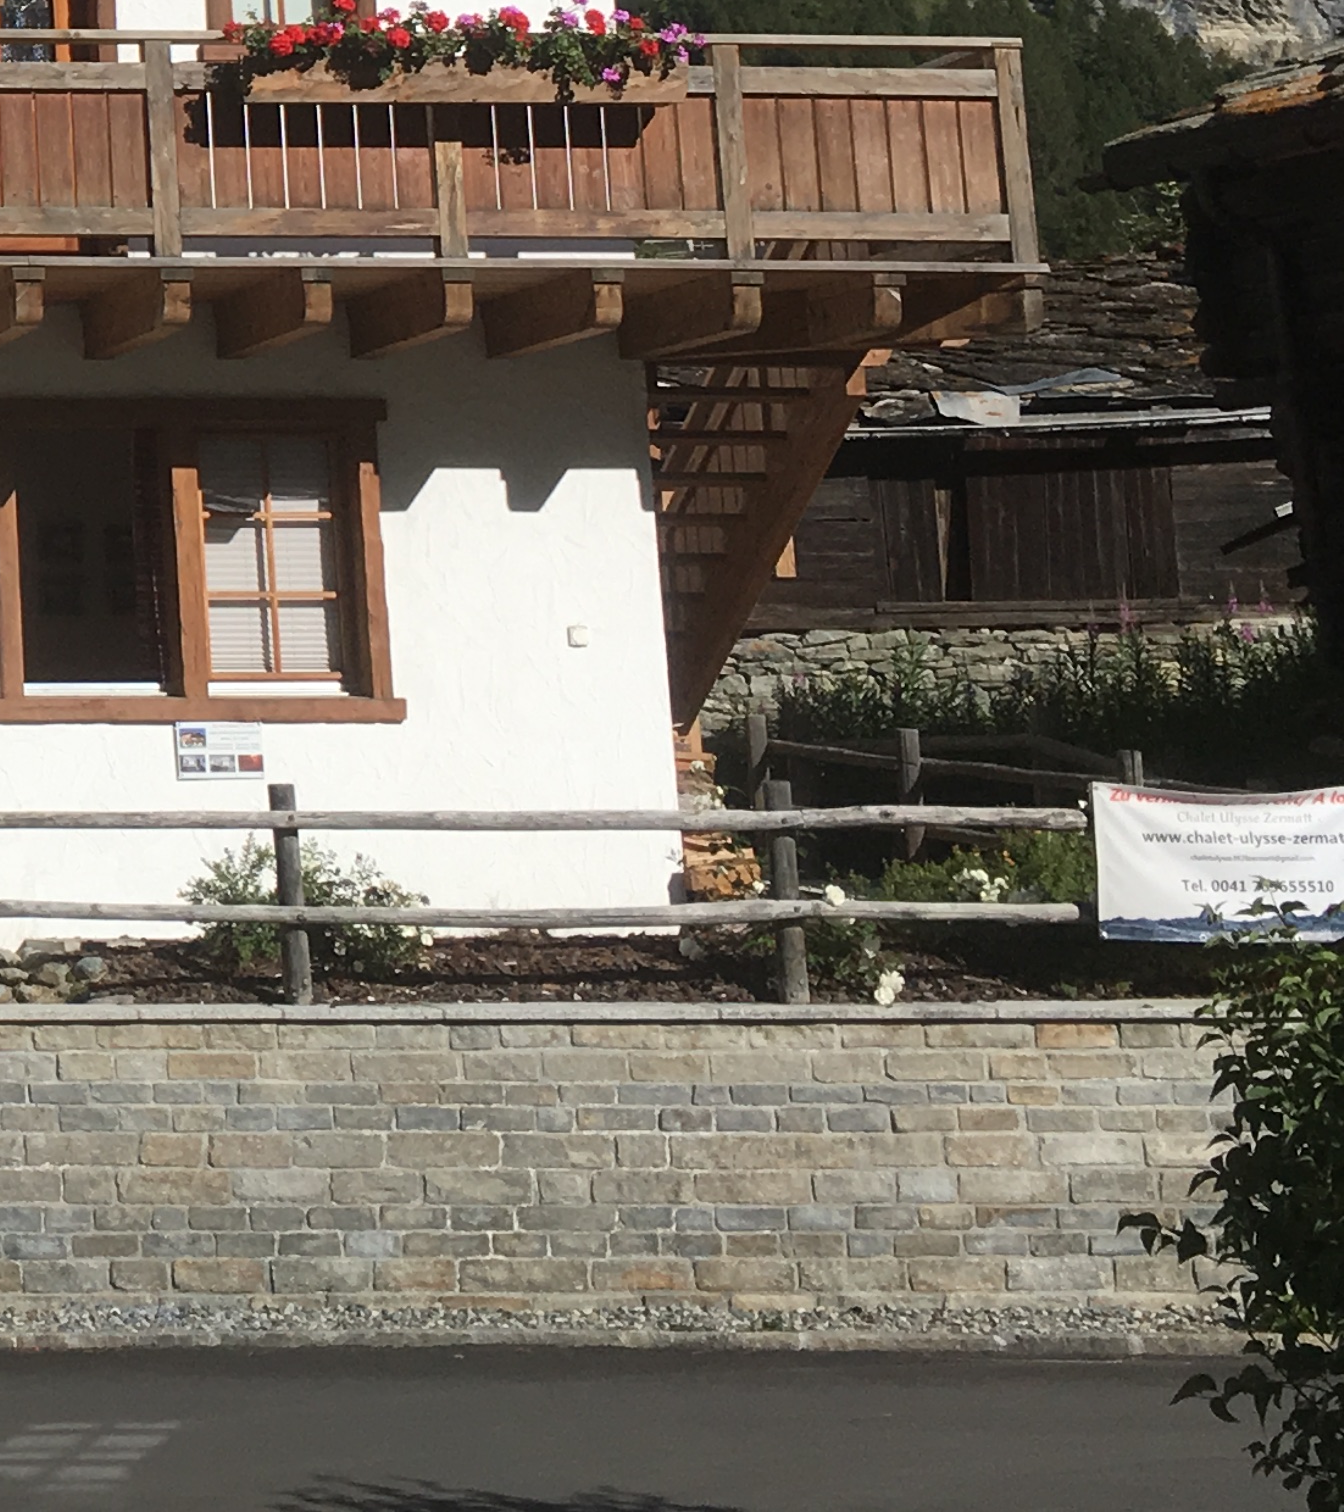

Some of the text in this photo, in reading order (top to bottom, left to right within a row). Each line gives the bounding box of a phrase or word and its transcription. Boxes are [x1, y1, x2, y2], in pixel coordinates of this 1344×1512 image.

[1177, 811, 1312, 826] Chalet Ulysse Zermatt
[1181, 879, 1207, 892] Tel.
[1211, 879, 1247, 892] 0041
